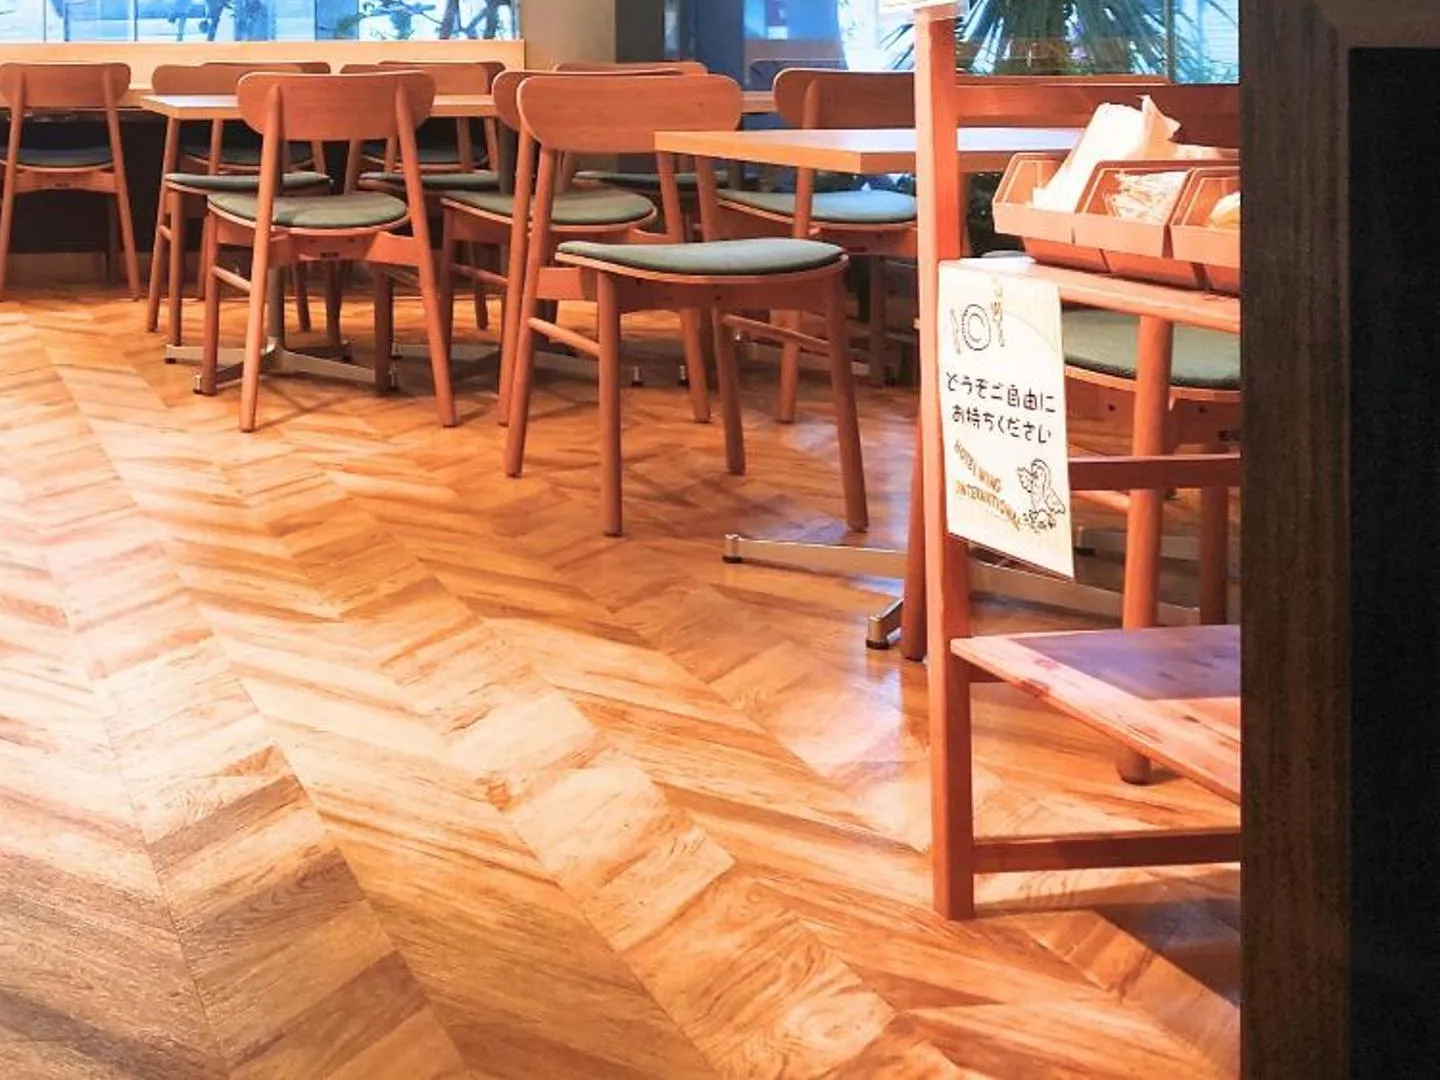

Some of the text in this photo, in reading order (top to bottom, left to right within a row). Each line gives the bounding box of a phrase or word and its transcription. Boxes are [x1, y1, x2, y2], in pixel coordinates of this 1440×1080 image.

[946, 371, 1057, 414] どうぞご自由に
[951, 403, 1052, 445] お持ちください
